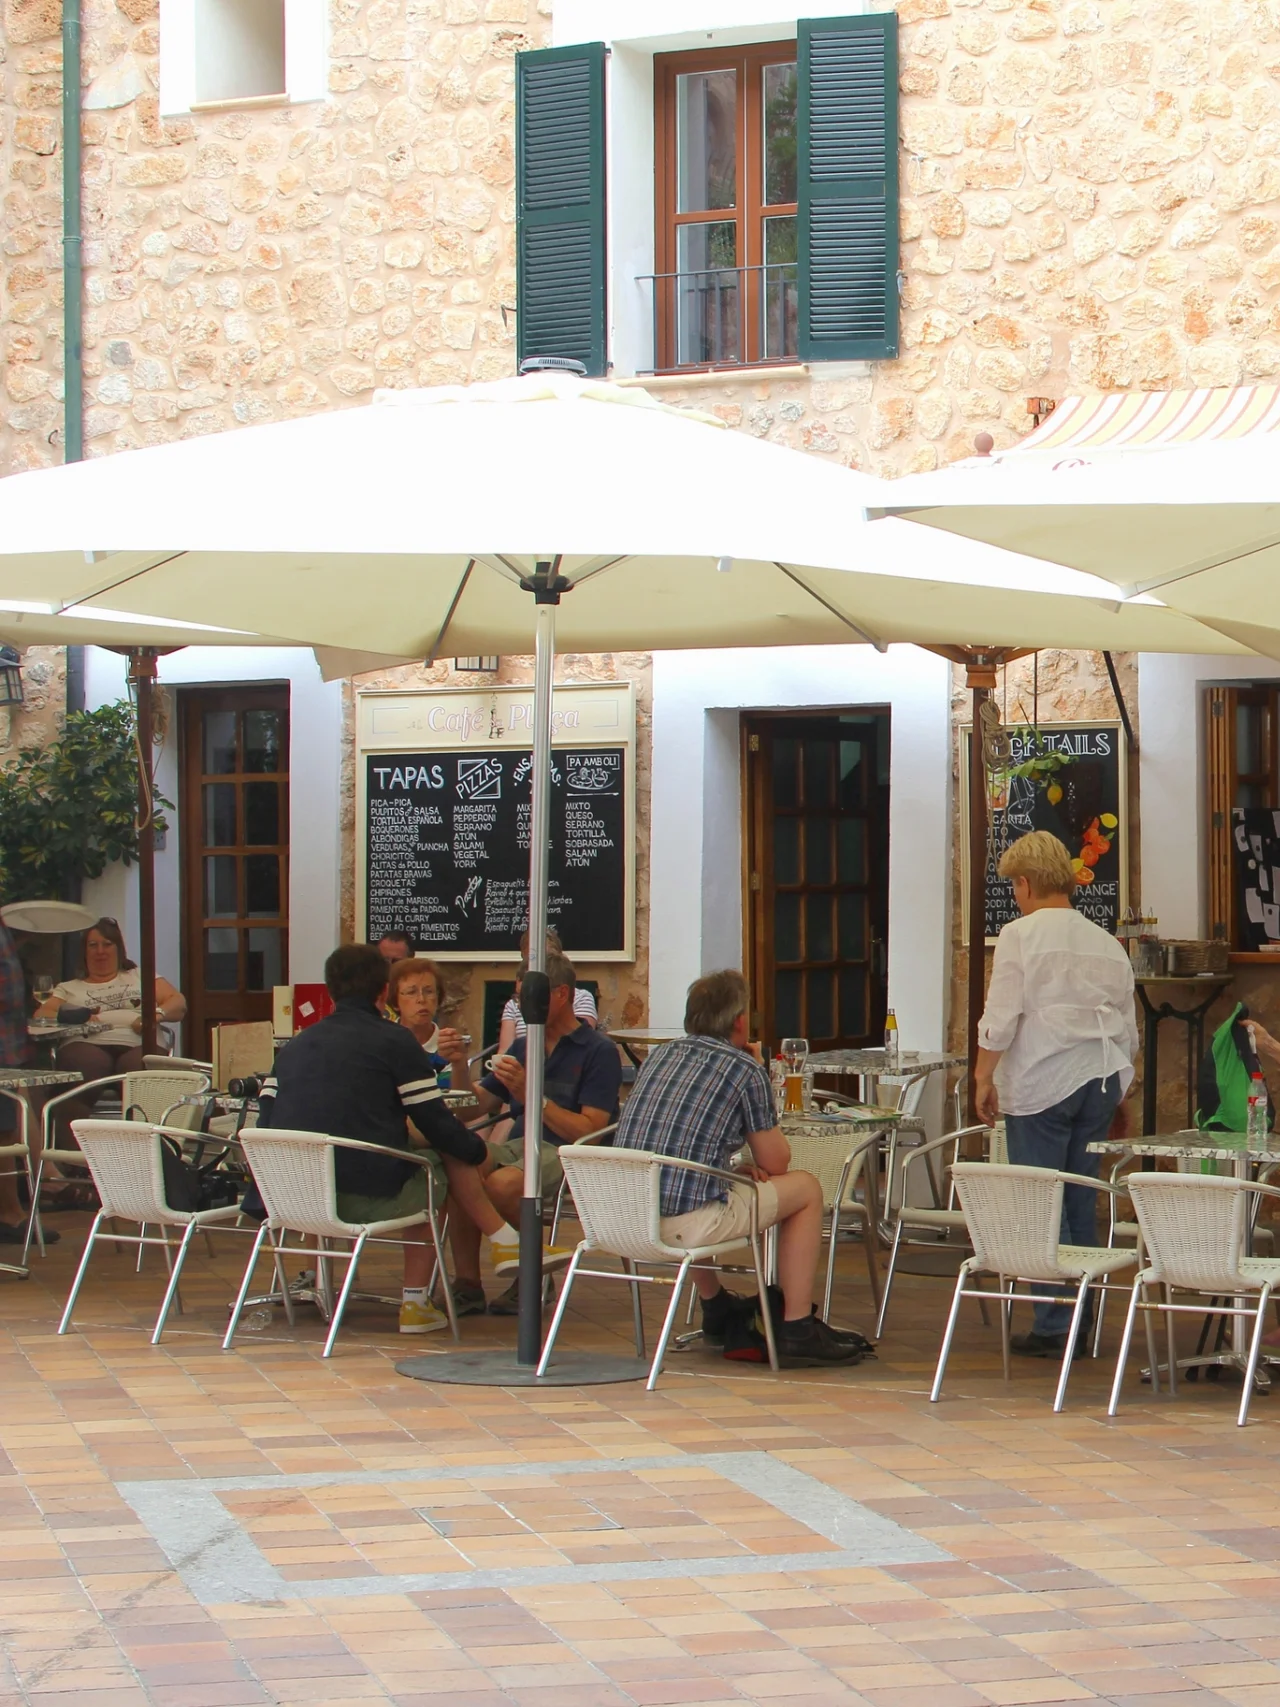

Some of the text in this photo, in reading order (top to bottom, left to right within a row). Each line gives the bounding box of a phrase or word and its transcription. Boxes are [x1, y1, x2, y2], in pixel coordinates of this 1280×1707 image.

[428, 704, 580, 742] Café Plça
[992, 733, 1111, 757] CKTAILS
[570, 757, 616, 766] PA AMB OLI
[373, 765, 444, 789] TAPAS
[455, 758, 502, 799] PIZZAS
[453, 804, 497, 813] MARGARITA
[565, 802, 590, 810] MIXTO
[371, 807, 405, 816] PULPITOS
[413, 807, 439, 815] SALSA
[565, 811, 593, 820] QUESO
[371, 815, 443, 825] TORTILLA ESPAÑOLA
[453, 814, 496, 822] PEPPERONI
[988, 814, 1032, 824] GARITA
[453, 823, 492, 831] SERRANO
[565, 820, 604, 829] SERRANO
[371, 825, 419, 834] BOQUERONES
[565, 830, 606, 838] TORTILLA
[371, 843, 408, 851] VERDURAS
[417, 842, 449, 851] PLANCHA
[516, 840, 553, 849] TOE
[565, 839, 614, 848] SOBRASADA
[371, 852, 415, 860] CHORICITOS
[453, 851, 489, 859] VEGETAL
[565, 849, 597, 857] SALAMI
[371, 861, 396, 869] ALITAS
[407, 861, 430, 869] POLLO
[453, 860, 476, 868] YORK
[370, 870, 432, 878] PATATAS BRAVAS
[370, 879, 416, 887] CROQUETAS
[370, 888, 412, 896] CHIPIRONES
[1074, 883, 1116, 896] RANGE
[370, 897, 393, 905] FRITO
[1075, 905, 1114, 917] EMON
[420, 932, 457, 940] RELLENAS
